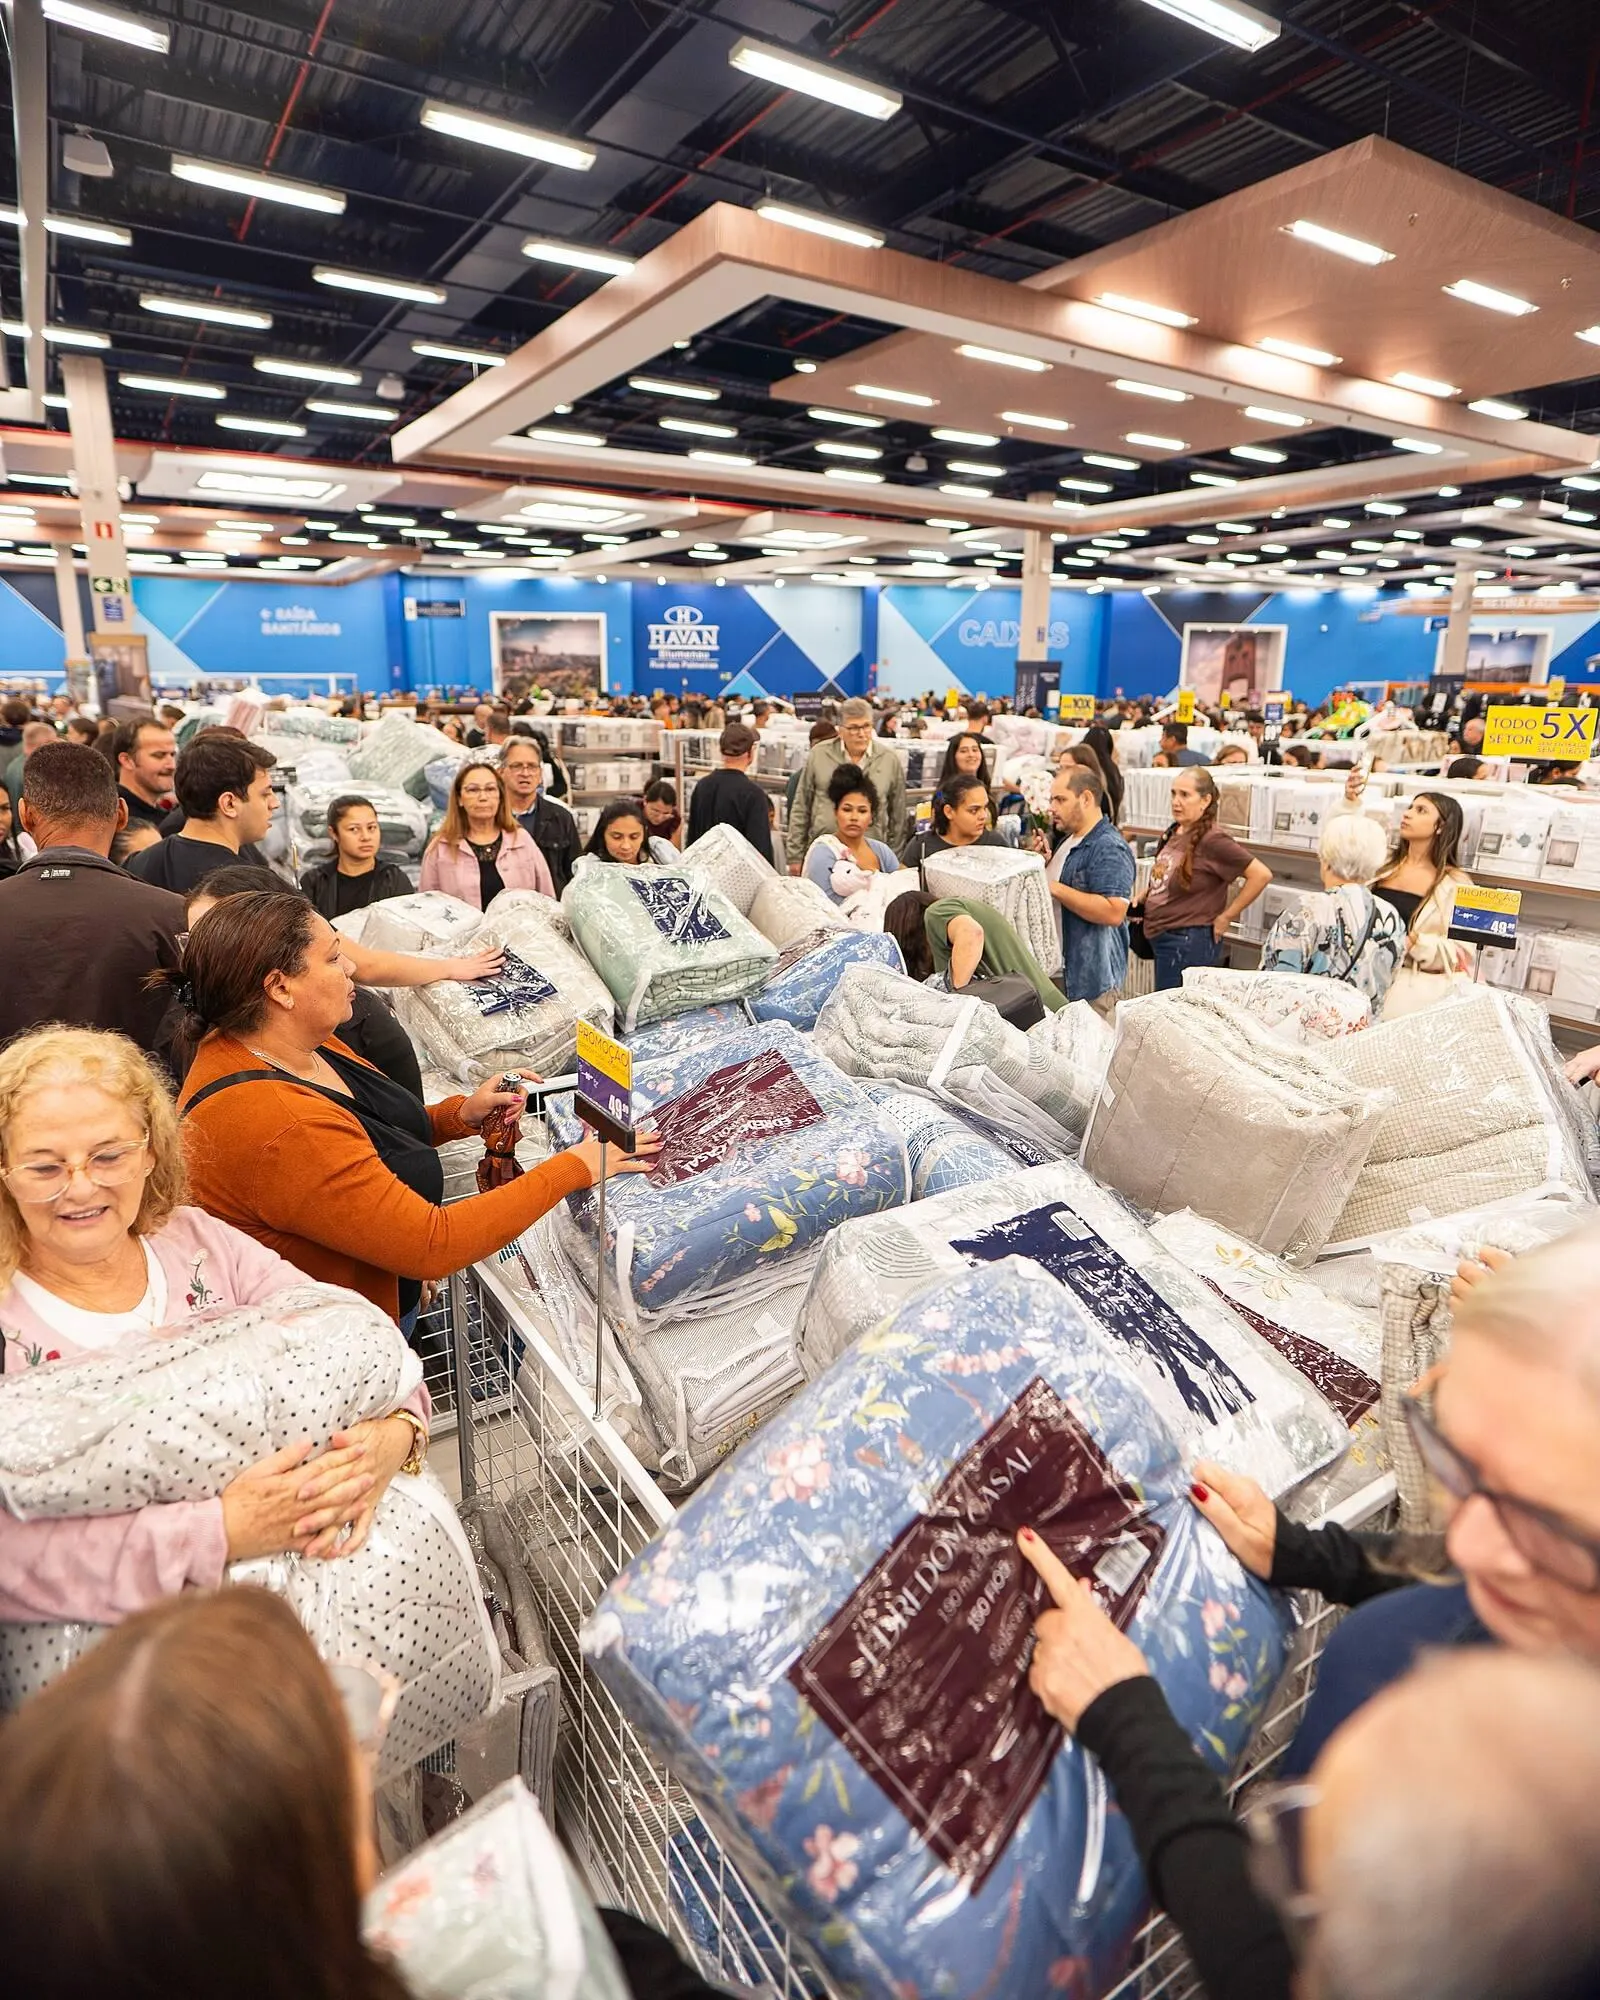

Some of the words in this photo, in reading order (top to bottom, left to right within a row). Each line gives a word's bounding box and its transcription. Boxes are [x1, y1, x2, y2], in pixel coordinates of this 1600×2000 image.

[647, 624, 720, 650] HAVAN
[958, 619, 1070, 649] CAIXS
[1489, 733, 1533, 745] SETOR
[1493, 718, 1537, 730] TODO
[1540, 712, 1590, 741] 5X
[578, 1023, 629, 1068] PROMOÇÃO
